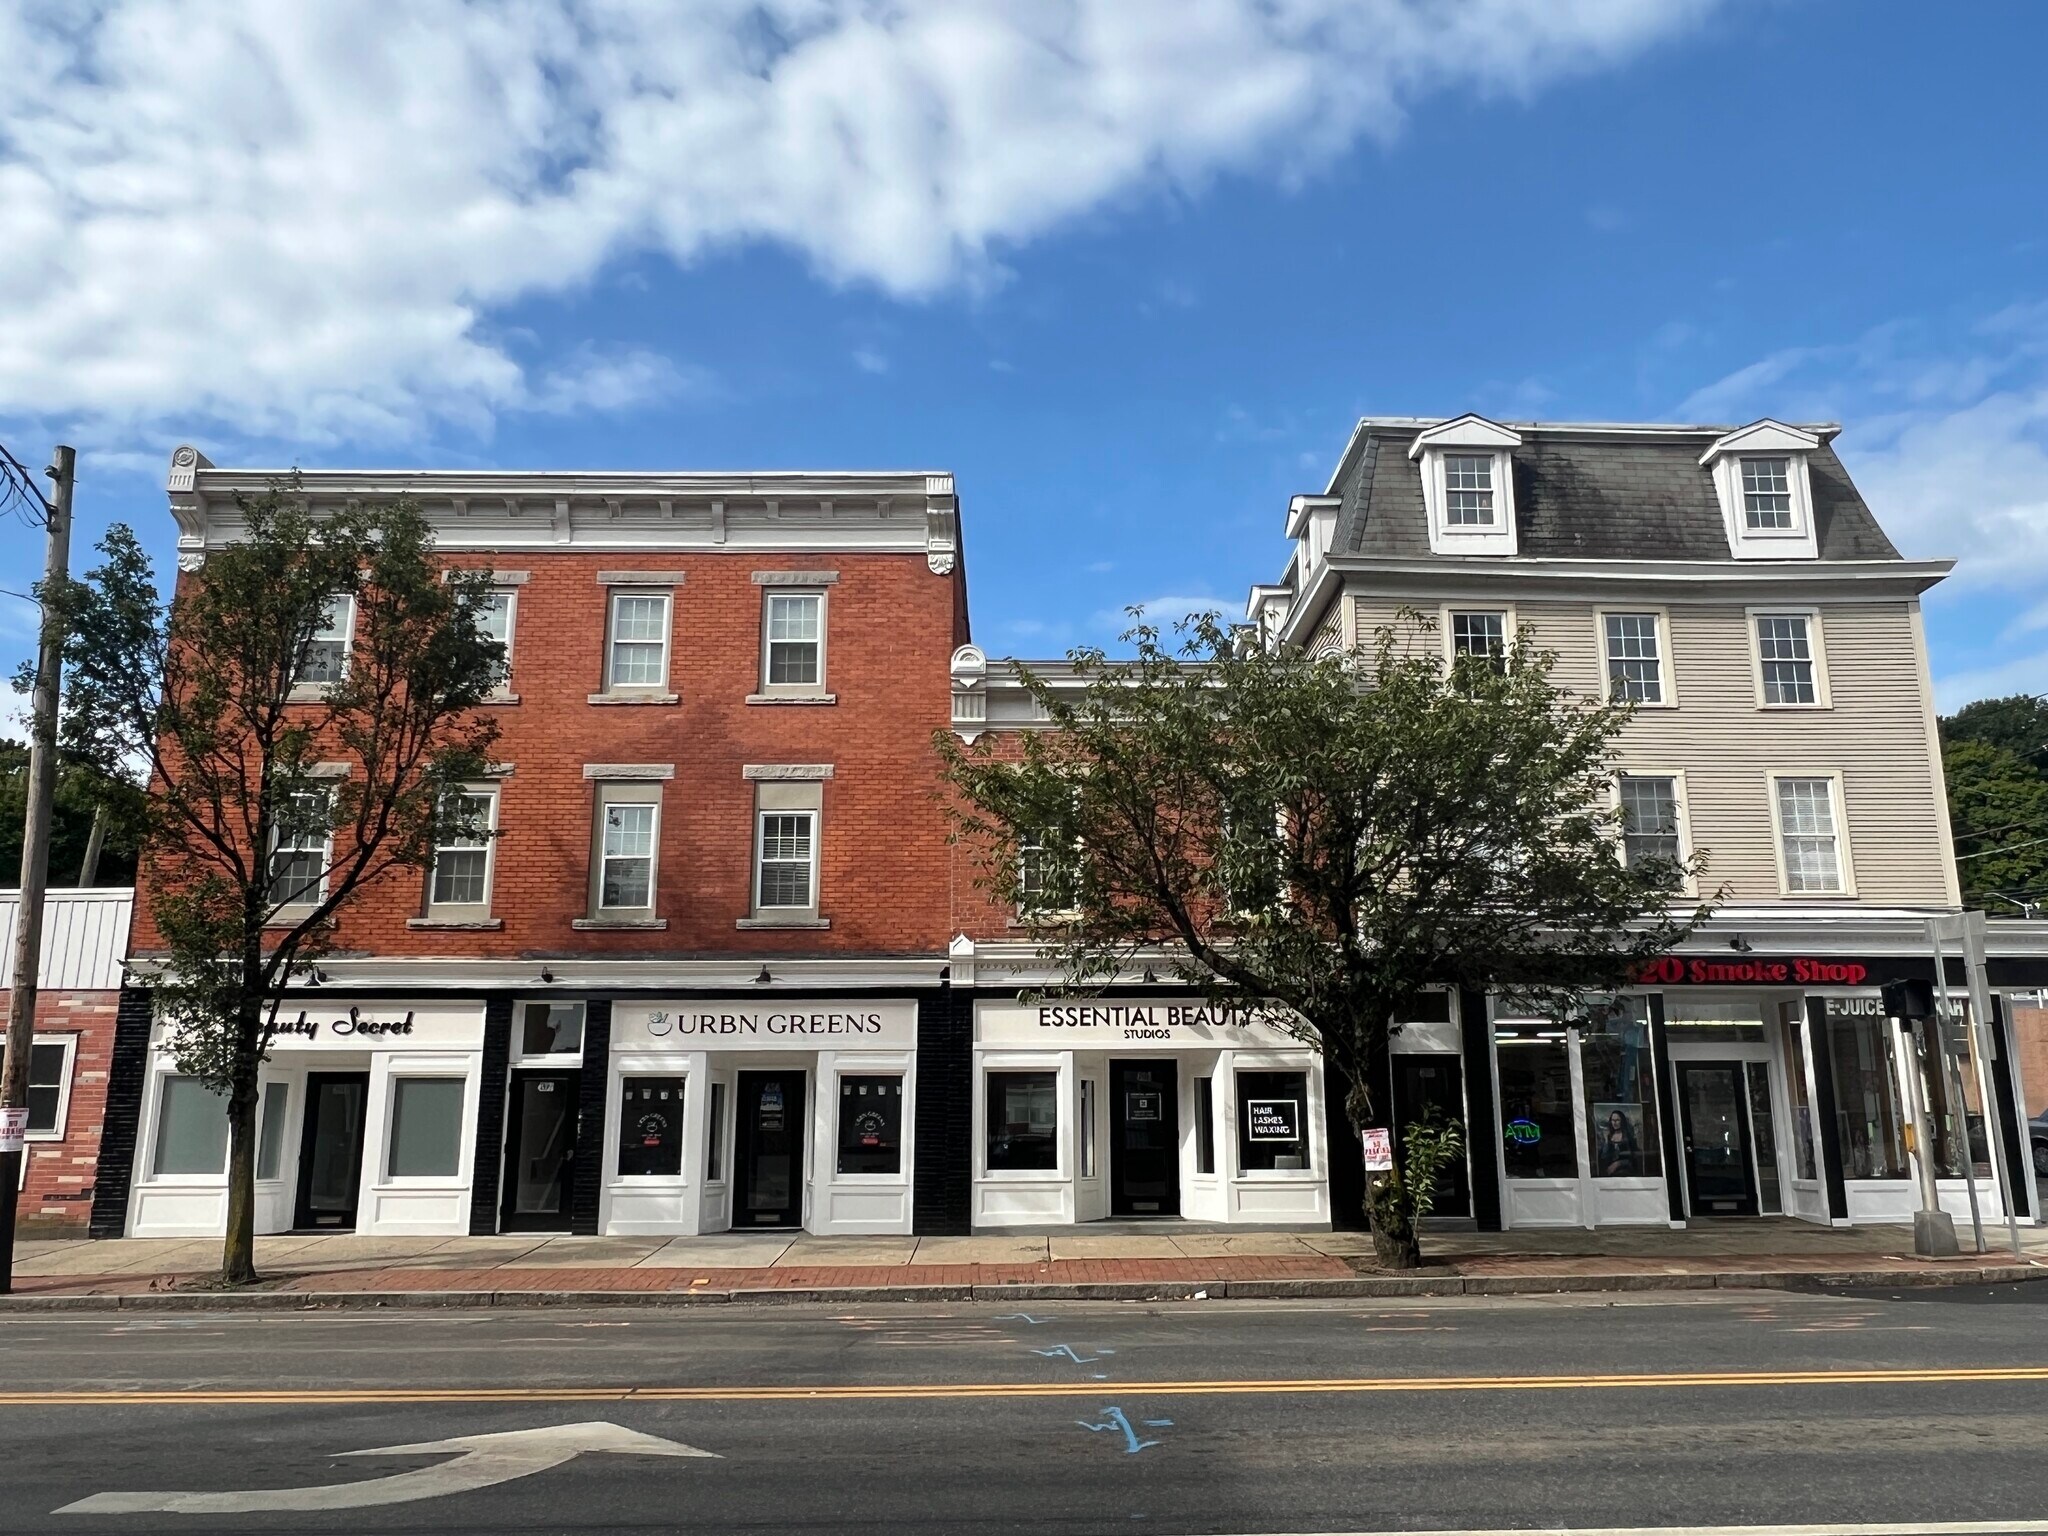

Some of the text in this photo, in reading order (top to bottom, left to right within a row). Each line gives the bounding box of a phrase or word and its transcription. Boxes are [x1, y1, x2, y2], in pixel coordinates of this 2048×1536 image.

[1630, 957, 1867, 985] 20 Smoke Shop
[1826, 999, 1886, 1016] E-JUICE
[332, 1006, 415, 1036] Secret
[1039, 1005, 1256, 1027] ESSENTIAL BEAUTY
[678, 1014, 882, 1035] URBN GREENS
[1124, 1029, 1171, 1040] STUDIOS
[1253, 1107, 1273, 1115] HAIR
[1253, 1116, 1284, 1125] LASHES
[1254, 1125, 1290, 1134] WAXING
[1504, 1124, 1540, 1139] ATM
